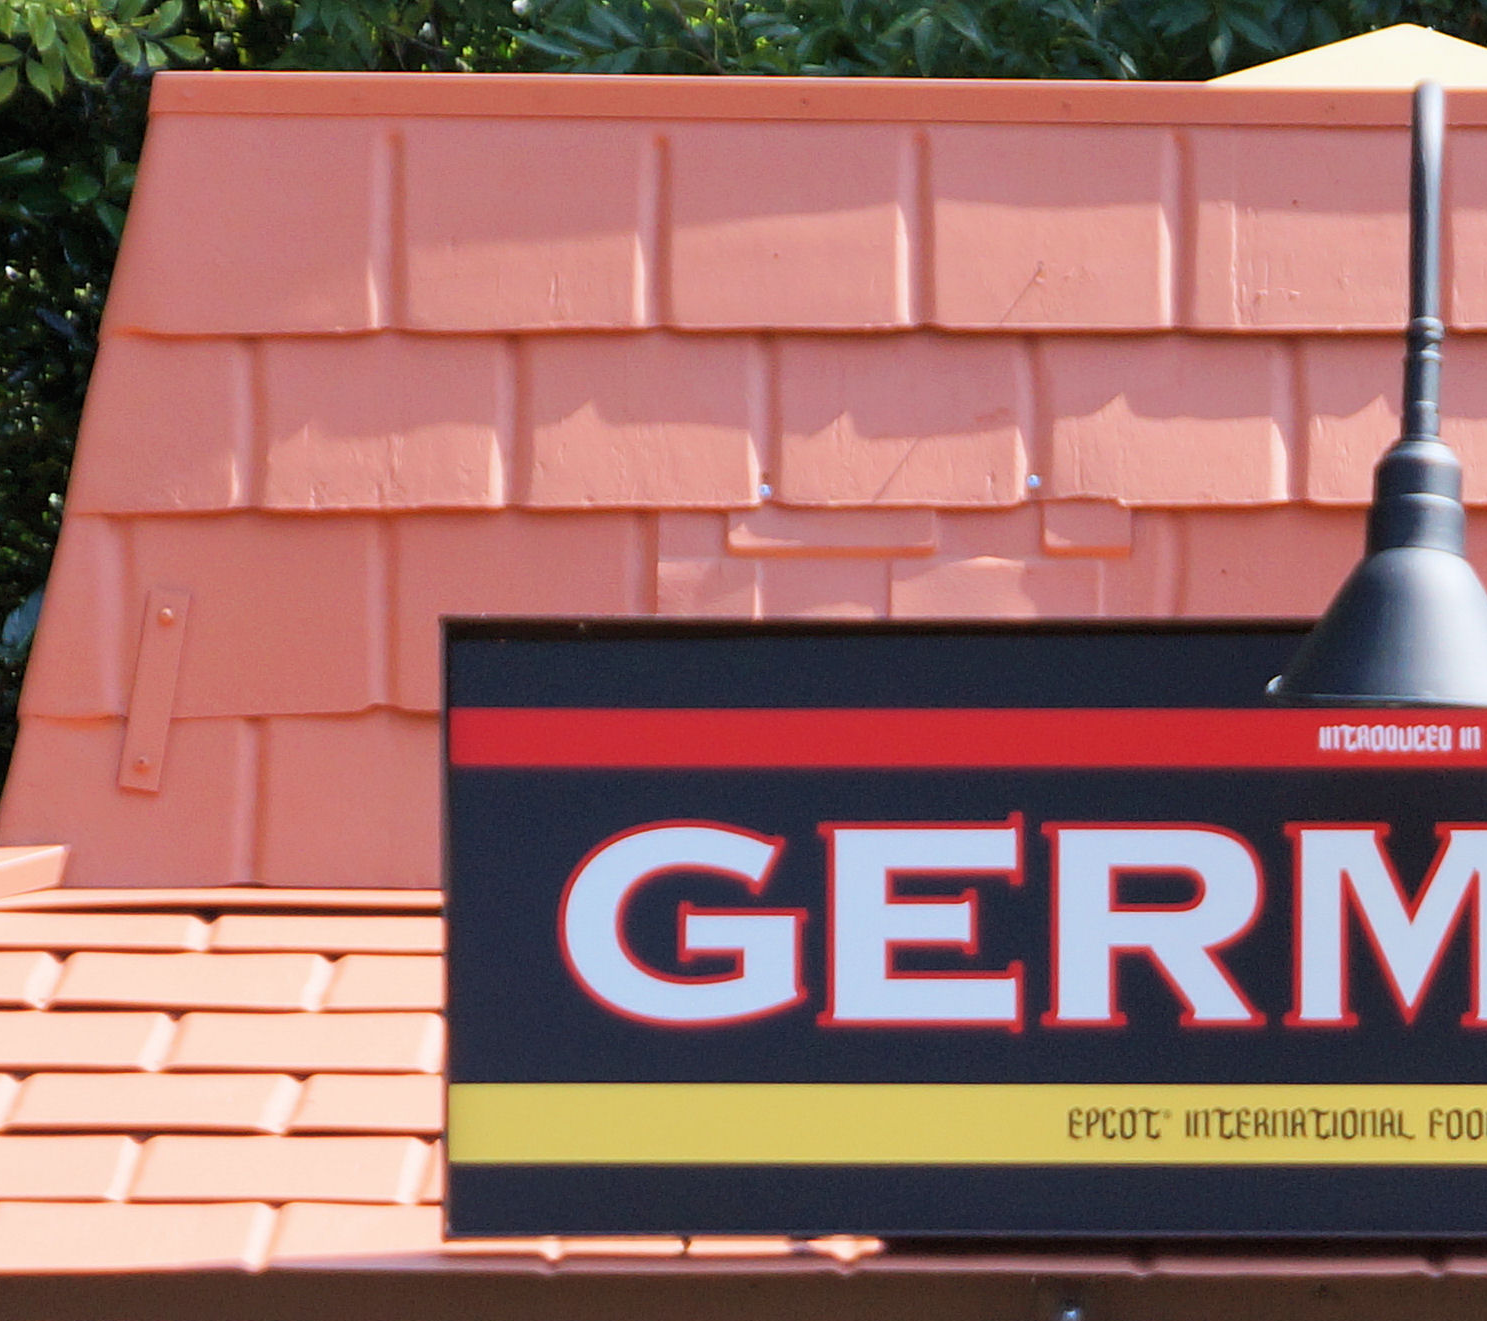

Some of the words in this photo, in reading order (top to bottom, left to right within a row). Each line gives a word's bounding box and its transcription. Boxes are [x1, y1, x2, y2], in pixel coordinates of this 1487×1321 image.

[1318, 725, 1452, 752] INTRODUCED
[1459, 726, 1481, 750] IN
[1184, 1108, 1415, 1140] INTERNATIONAL
